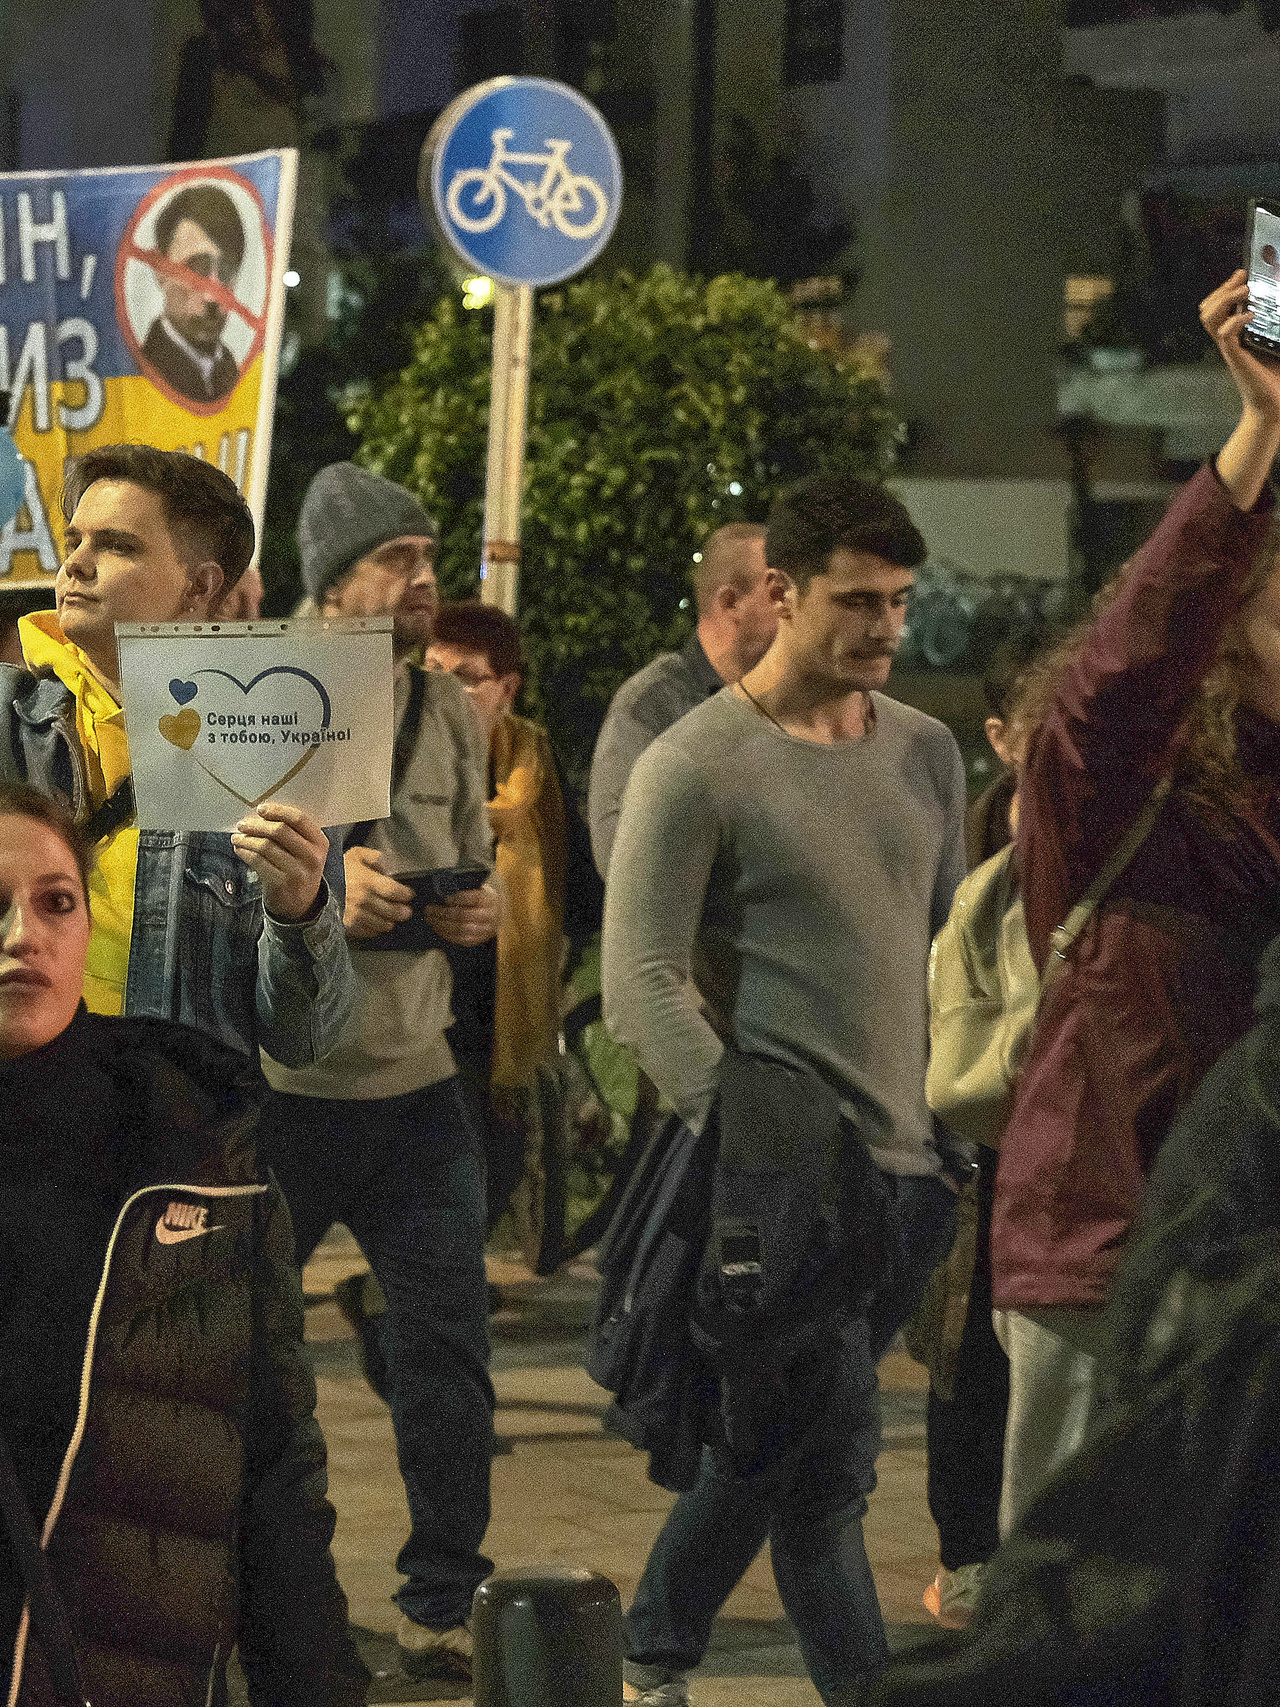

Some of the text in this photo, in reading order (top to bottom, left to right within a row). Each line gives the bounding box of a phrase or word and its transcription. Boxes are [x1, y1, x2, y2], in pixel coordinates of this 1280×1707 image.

[207, 711, 298, 728] Серця наші
[208, 728, 351, 745] з тобою, Україно!
[165, 1202, 209, 1230] NIKE
